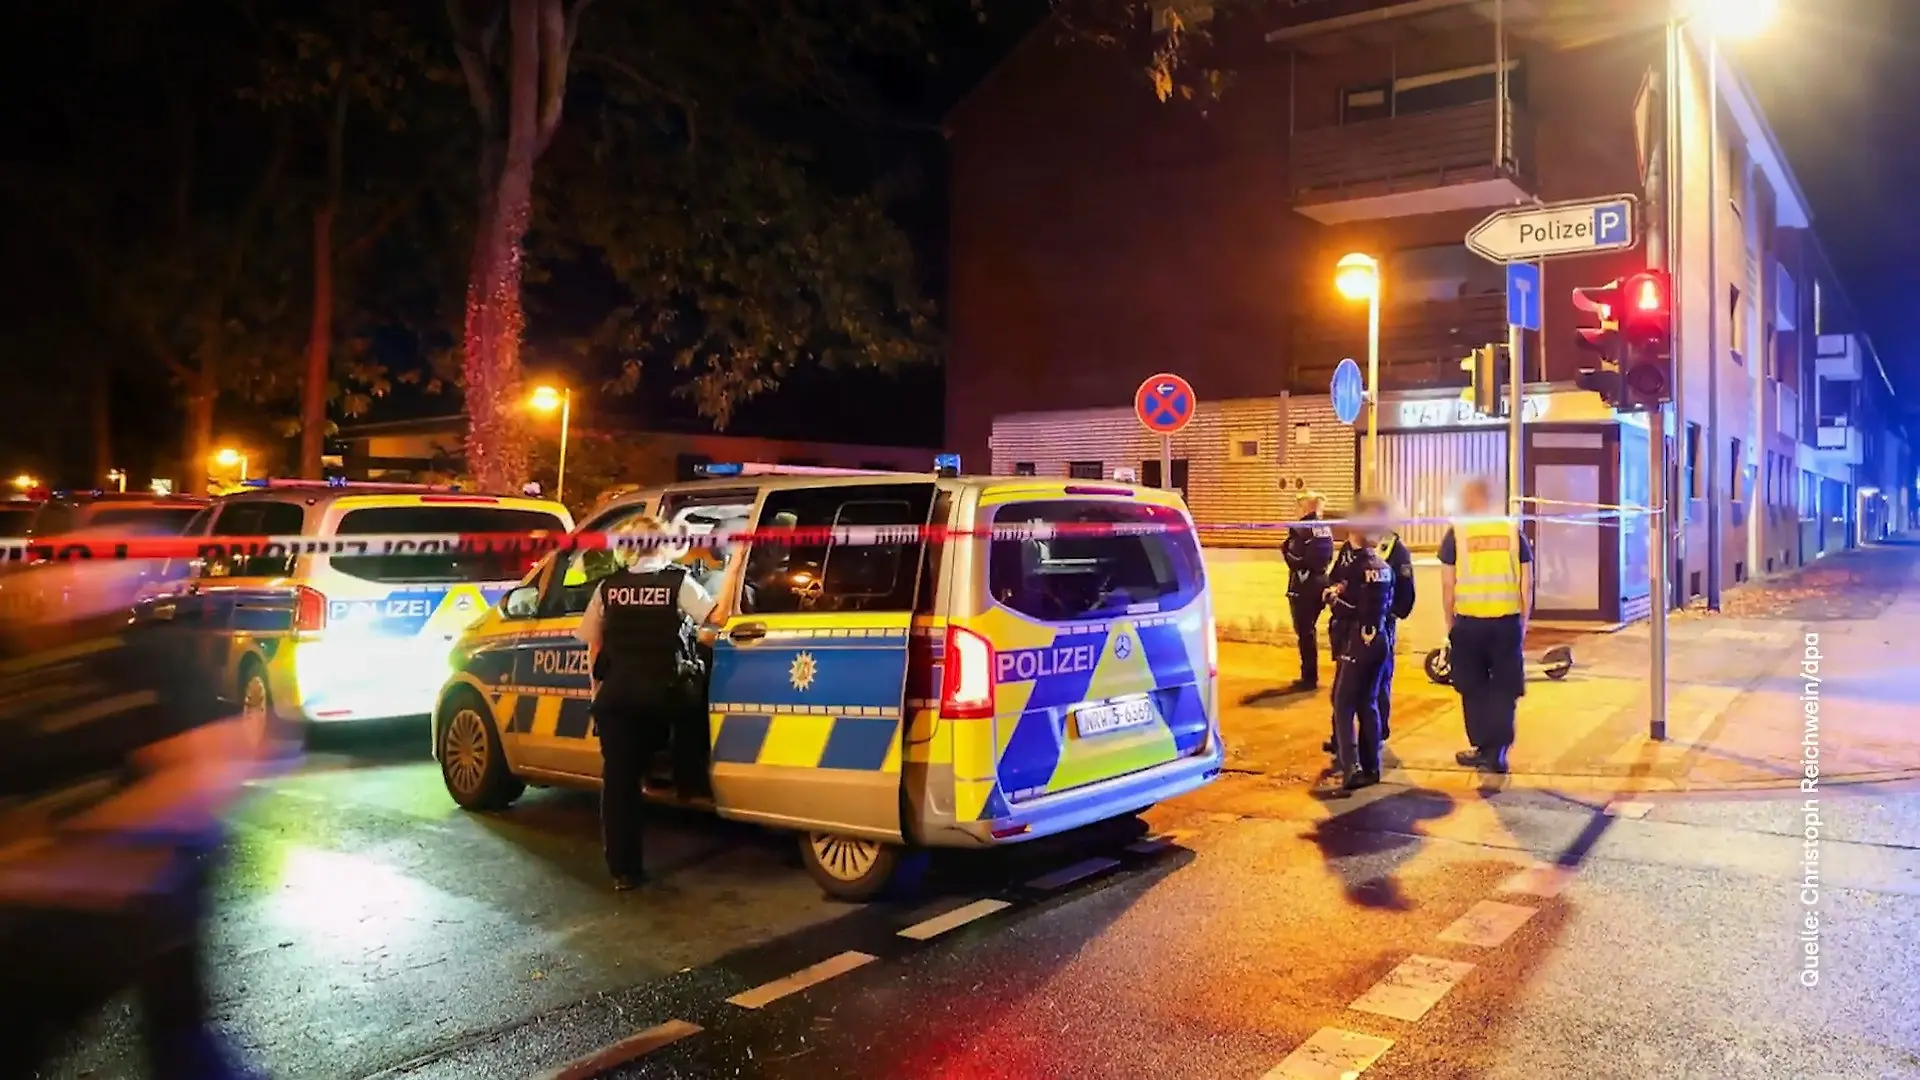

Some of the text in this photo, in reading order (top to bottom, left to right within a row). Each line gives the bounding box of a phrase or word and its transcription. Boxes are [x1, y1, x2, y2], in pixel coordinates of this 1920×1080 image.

[1520, 216, 1593, 243] Polizei
[607, 587, 670, 605] POLIZEI
[533, 650, 590, 673] POLIZE
[997, 644, 1095, 681] POLIZEI
